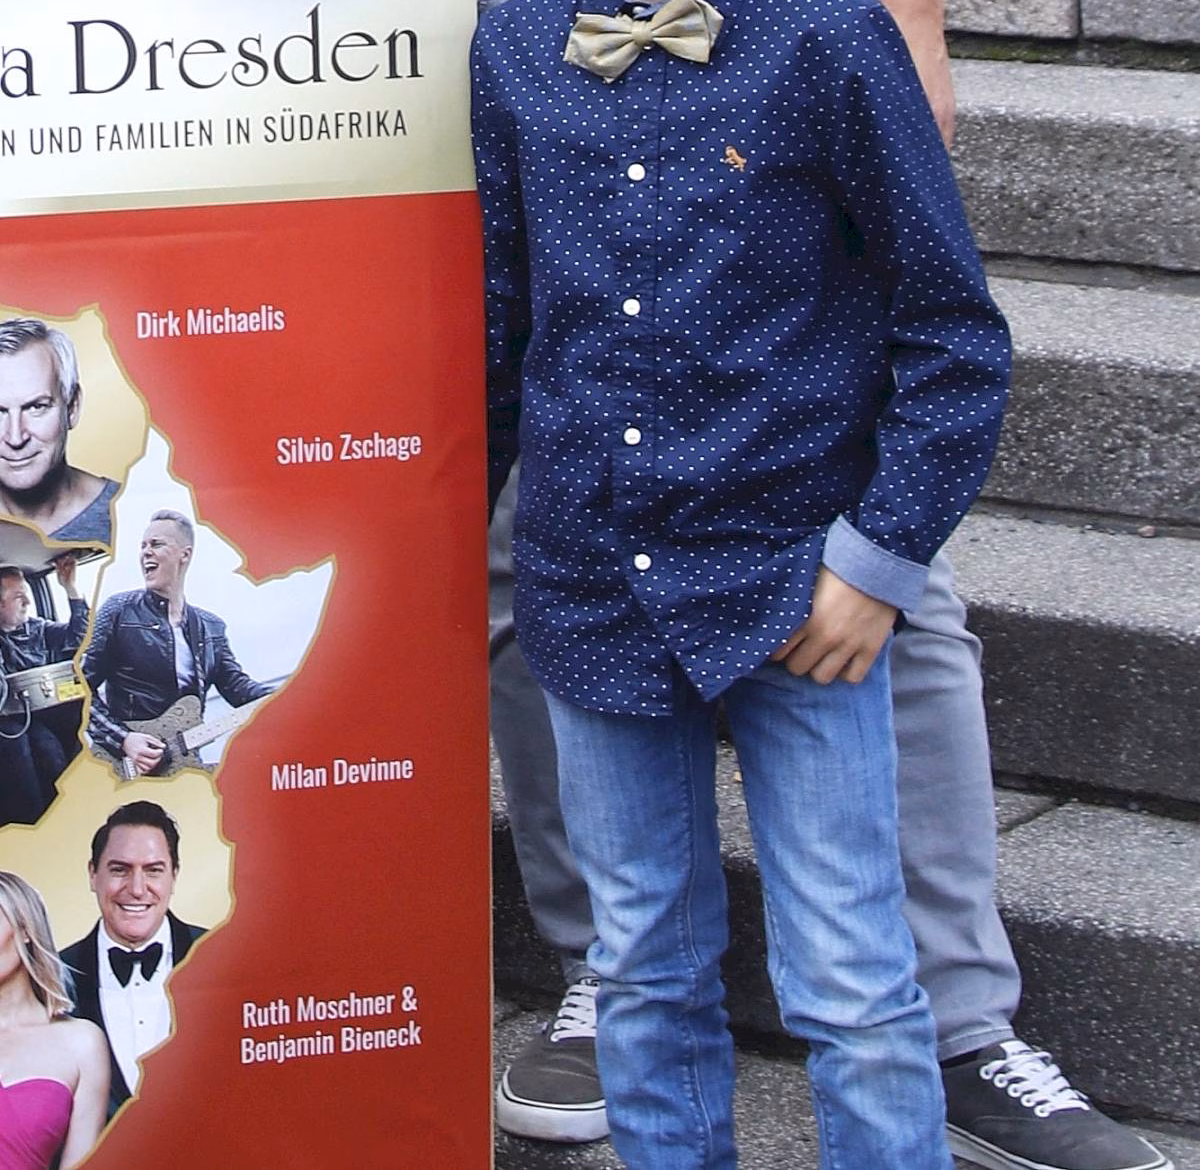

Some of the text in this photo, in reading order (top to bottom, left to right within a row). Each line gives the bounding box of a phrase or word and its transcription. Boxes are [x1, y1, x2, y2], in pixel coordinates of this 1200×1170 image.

[66, 2, 425, 96] Dresden
[28, 125, 83, 156] UND
[95, 118, 214, 153] FAMILIEN
[226, 115, 252, 146] IN
[263, 106, 409, 144] SÜDAFRIKA
[136, 304, 286, 339] Dirk Michaelis
[276, 432, 422, 465] Silvio Zschage
[271, 757, 414, 791] Milan Devinne
[242, 985, 418, 1029] Ruth Moschner &
[240, 1020, 422, 1064] Benjamin Bieneck
